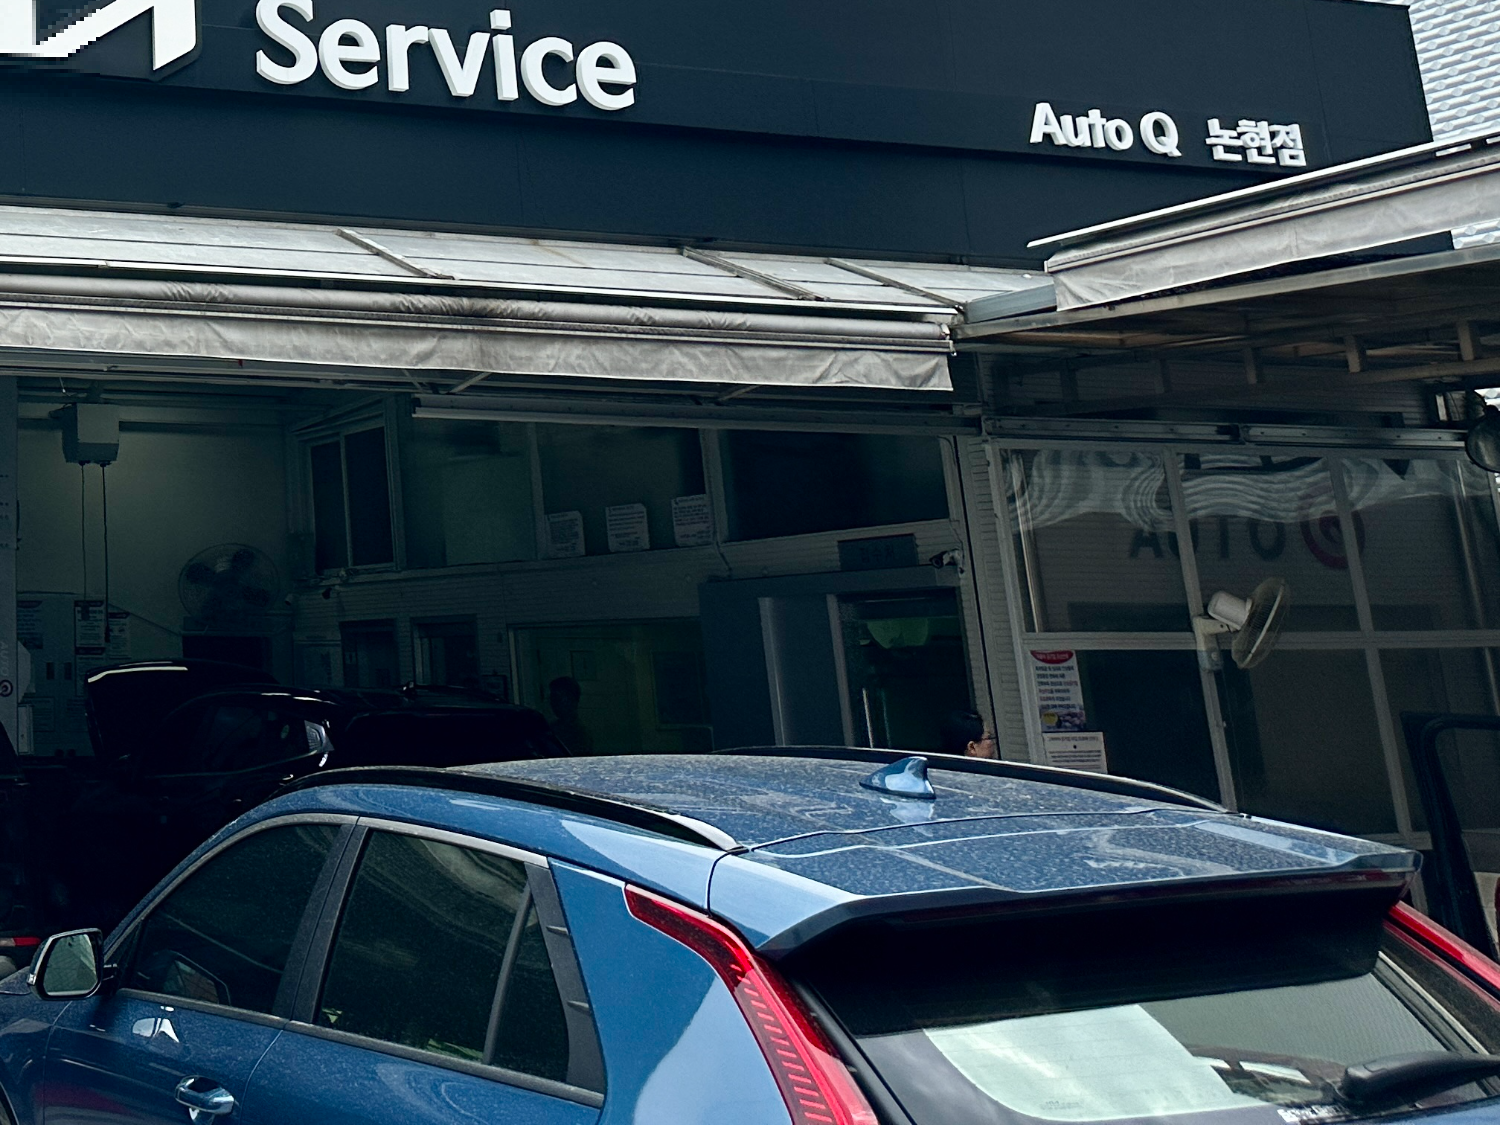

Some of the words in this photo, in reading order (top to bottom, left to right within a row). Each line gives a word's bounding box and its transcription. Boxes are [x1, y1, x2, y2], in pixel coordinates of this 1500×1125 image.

[1029, 101, 1134, 151] Auto
[1139, 111, 1182, 157] Q
[1205, 117, 1307, 167] 논현점
